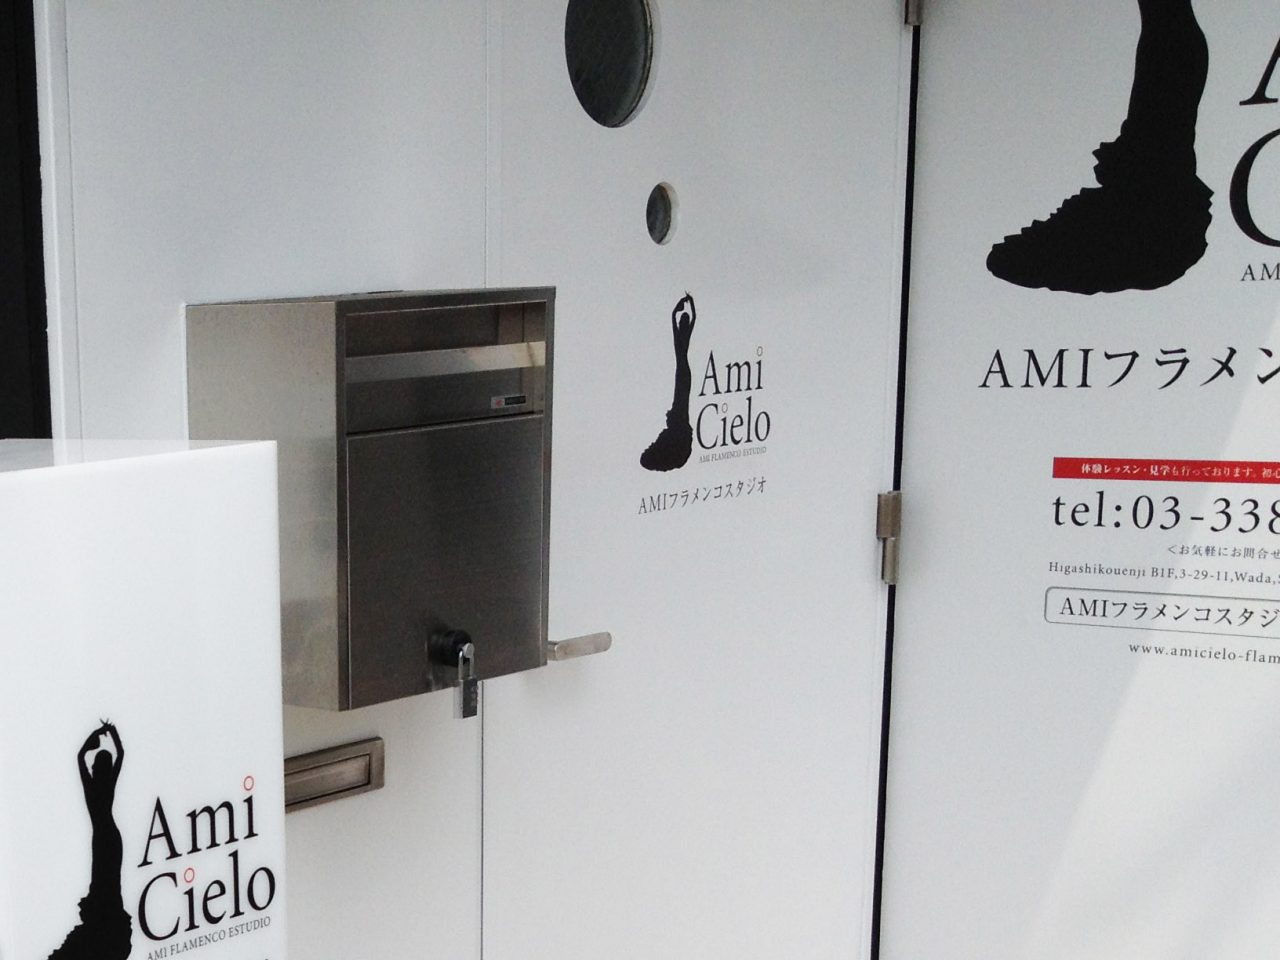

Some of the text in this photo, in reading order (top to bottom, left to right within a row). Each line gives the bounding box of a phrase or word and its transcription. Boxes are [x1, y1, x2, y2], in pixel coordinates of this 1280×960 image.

[698, 346, 764, 397] Ami
[978, 346, 1280, 390] AMIフラメン
[696, 396, 771, 450] Cielo
[638, 476, 767, 515] AMIフラメンコスタジオ
[1049, 561, 1280, 585] Higashikouenji B1F,3-29-11,Wada,
[1059, 597, 1280, 628] AMIフラメンコスタジ
[137, 775, 259, 868] Ami
[138, 849, 276, 941] Cielo
[169, 930, 226, 957] FLAMENCO
[228, 916, 271, 939] ESTUDIO
